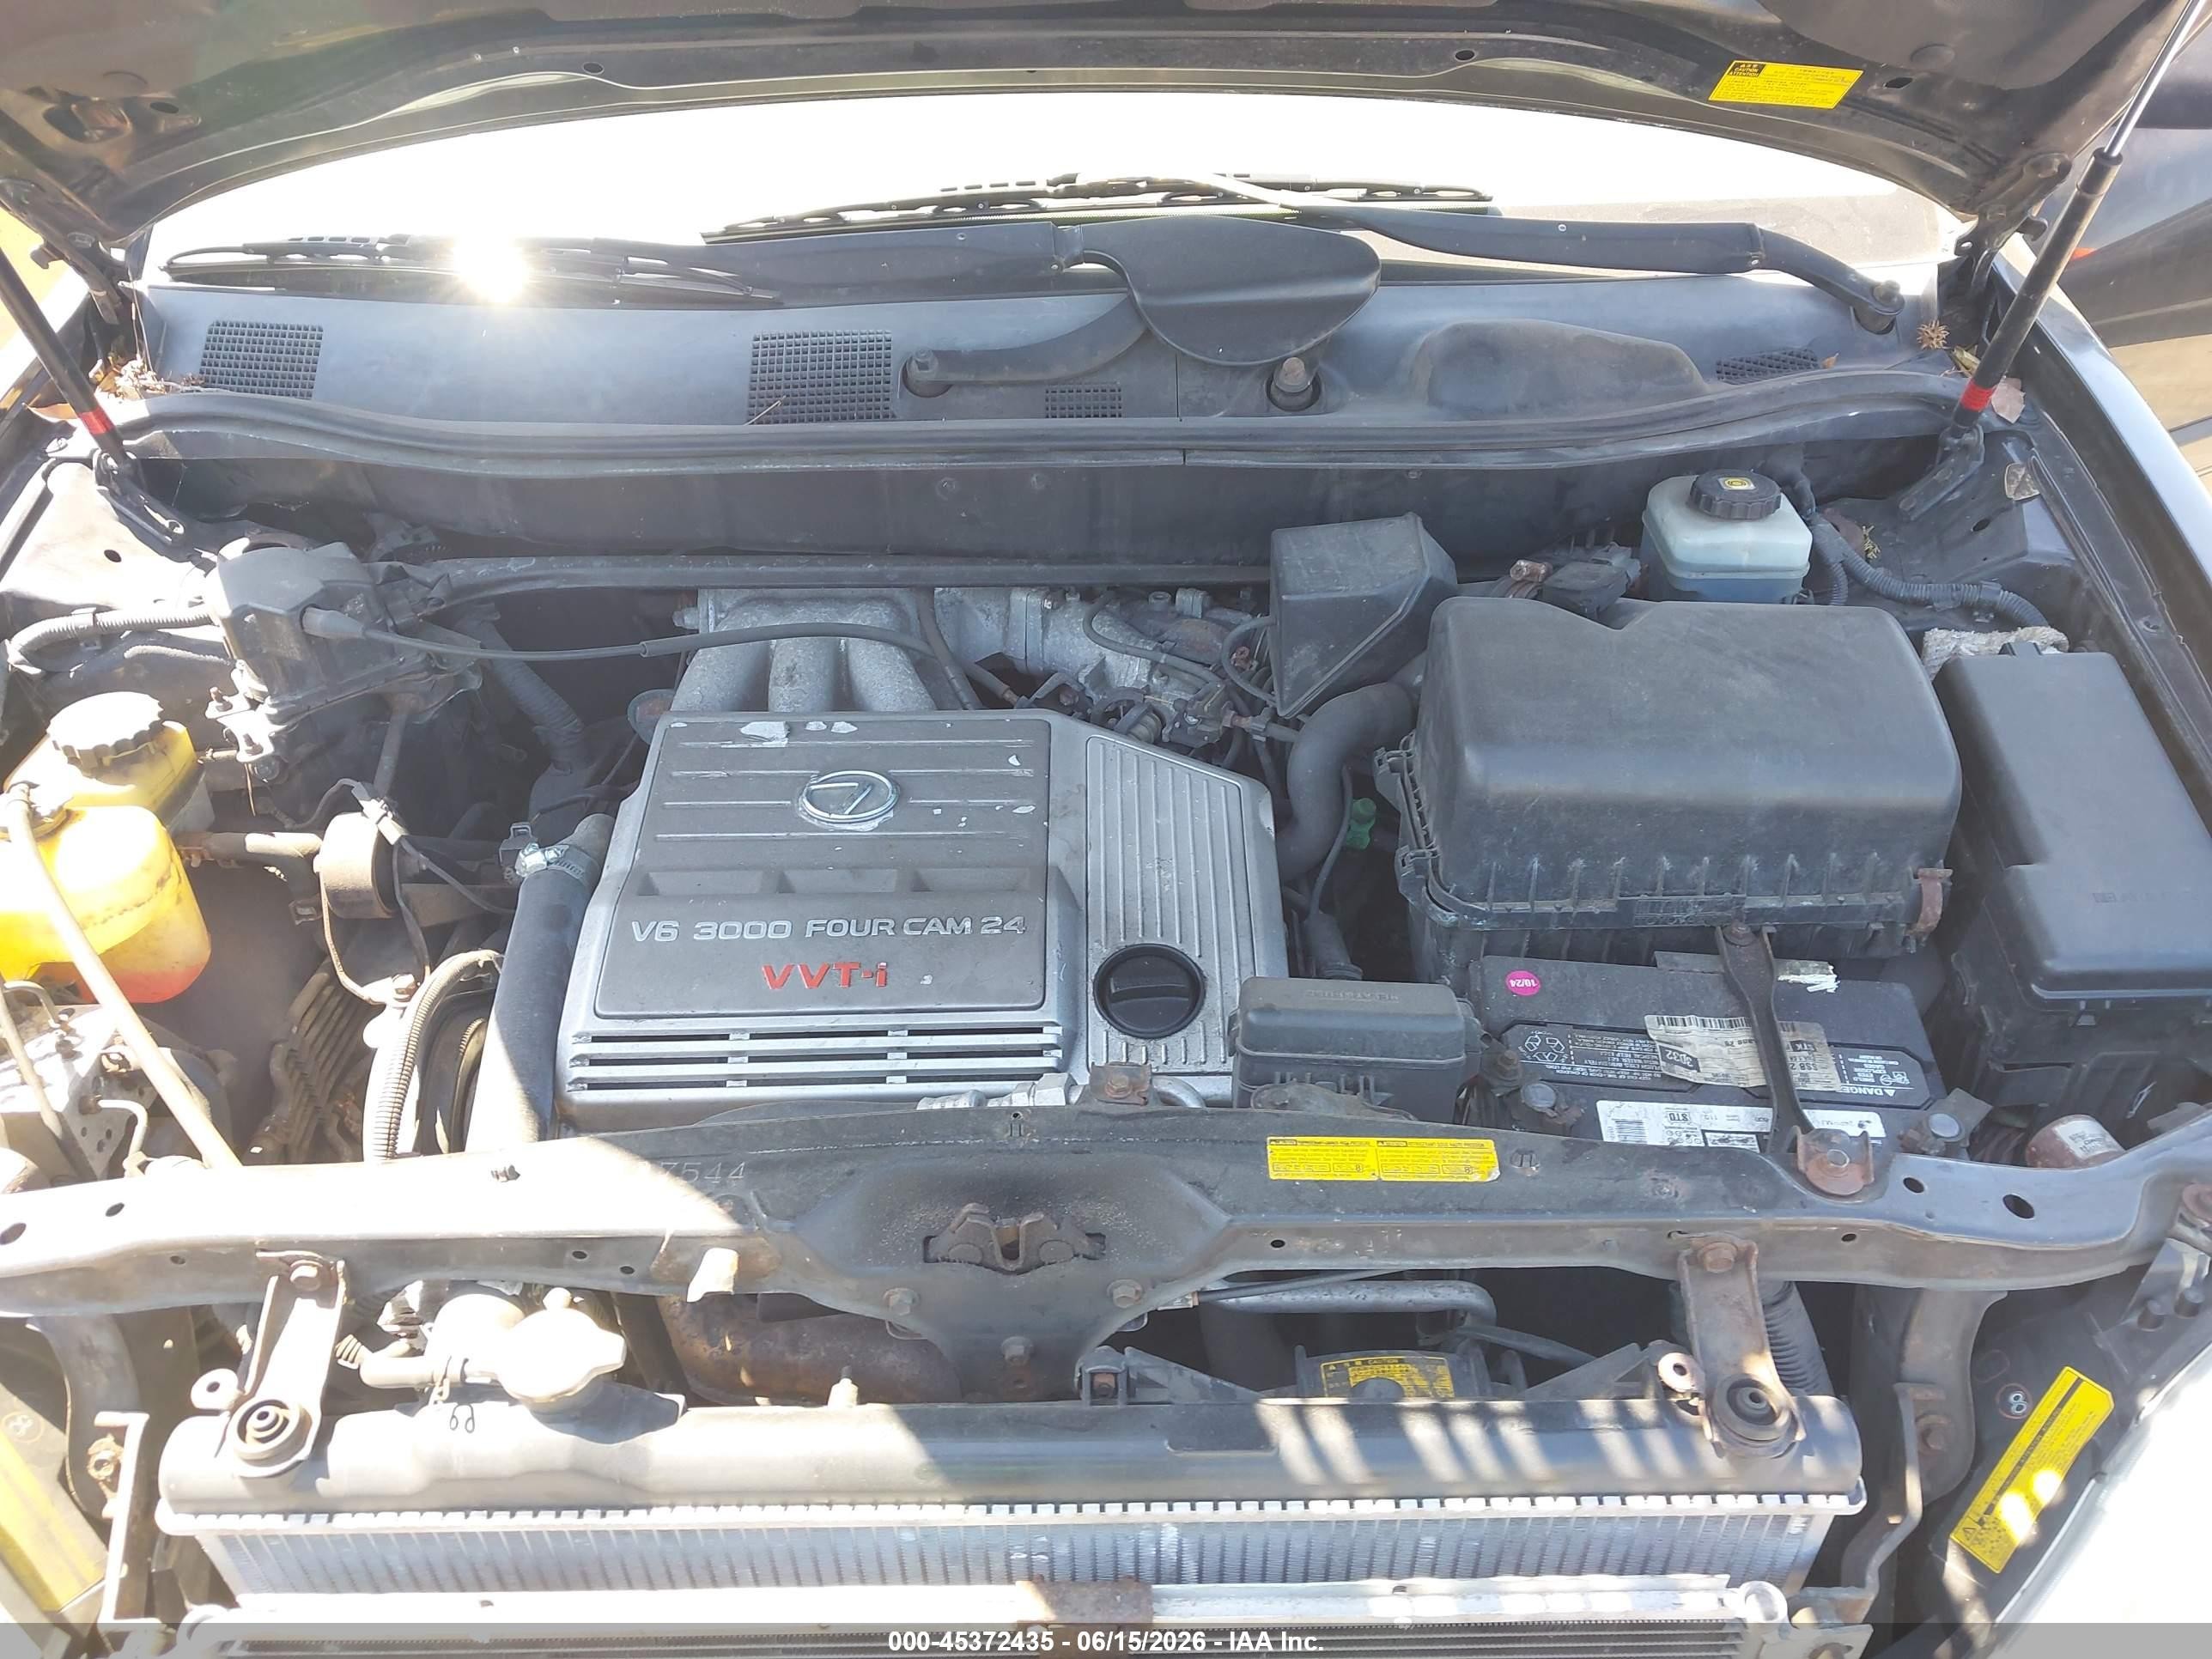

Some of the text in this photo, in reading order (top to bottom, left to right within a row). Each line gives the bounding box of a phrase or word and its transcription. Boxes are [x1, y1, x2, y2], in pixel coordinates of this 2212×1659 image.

[631, 915, 1026, 942] V6 3000 FOUR CAM 24
[763, 961, 889, 990] VVT-i
[1509, 979, 1538, 988] 10/24
[1665, 1049, 1693, 1066] 3D32
